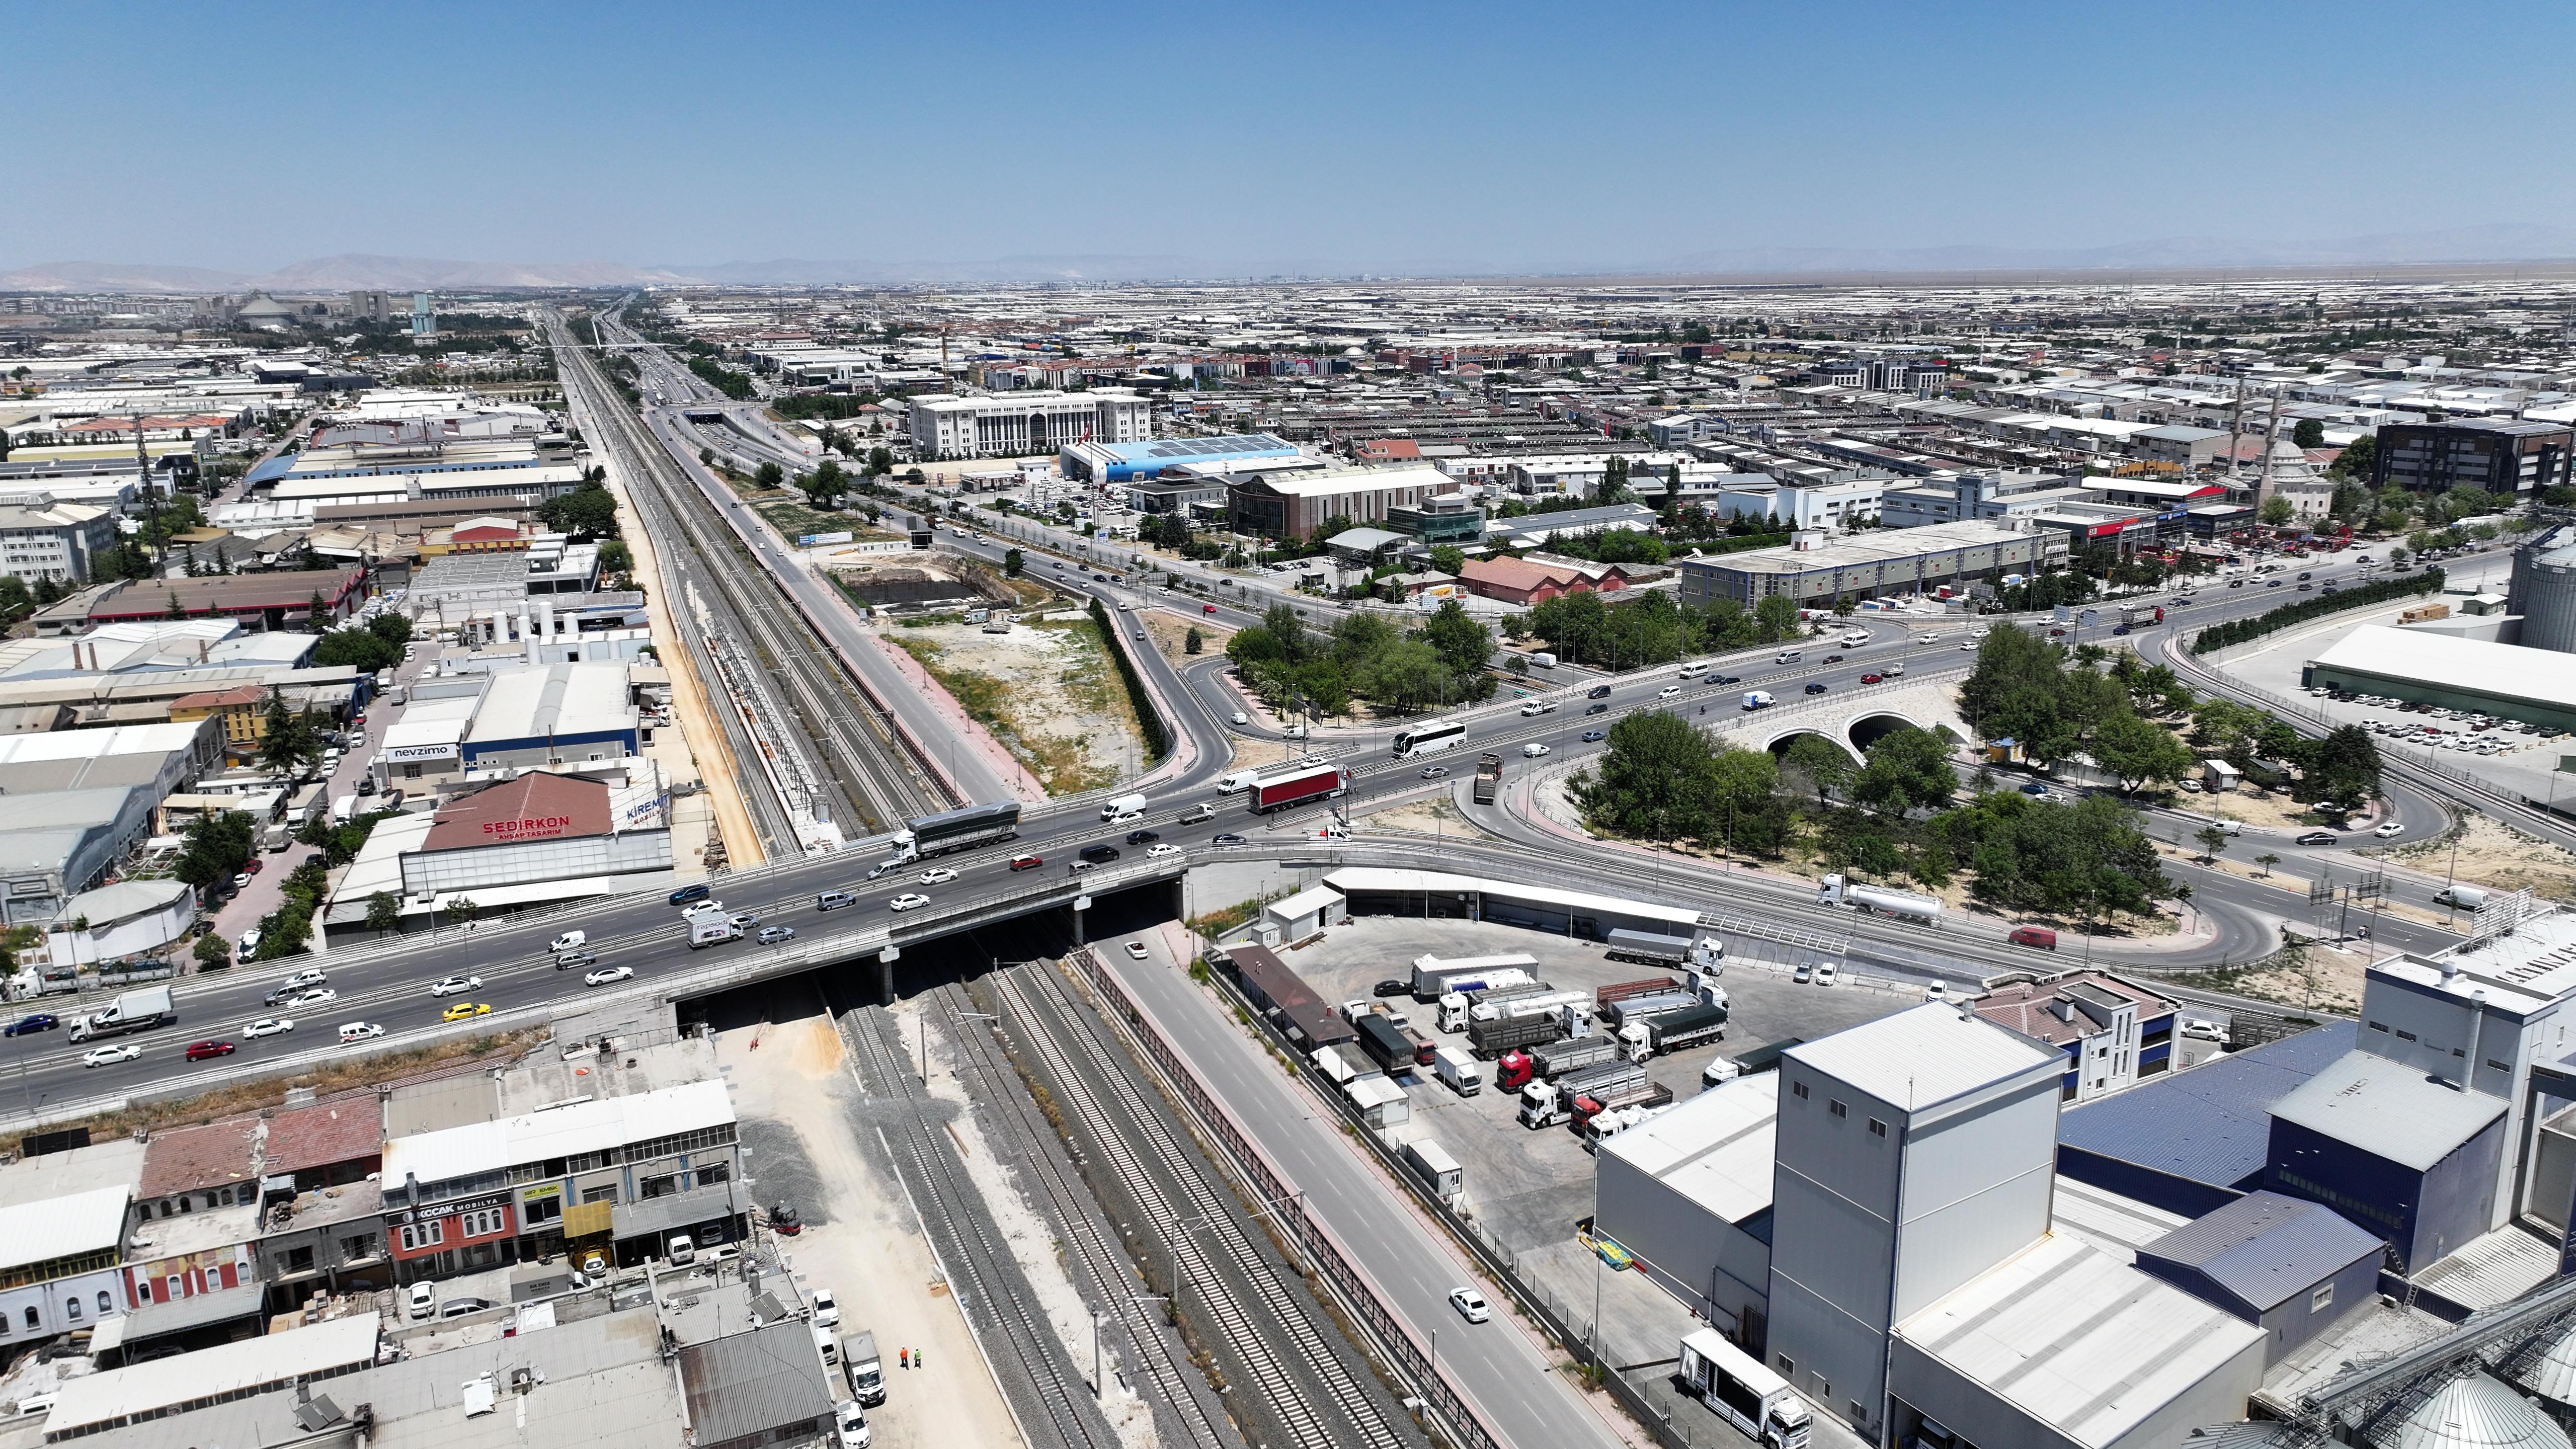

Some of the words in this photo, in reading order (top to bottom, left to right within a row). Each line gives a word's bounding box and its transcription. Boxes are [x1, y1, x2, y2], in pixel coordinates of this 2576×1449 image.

[395, 747, 448, 757] nevzimo
[483, 816, 570, 833] SEDİRKON
[525, 829, 561, 837] TASARIM
[417, 1204, 455, 1219] KOÇAK
[457, 1198, 498, 1211] MOBİLYA
